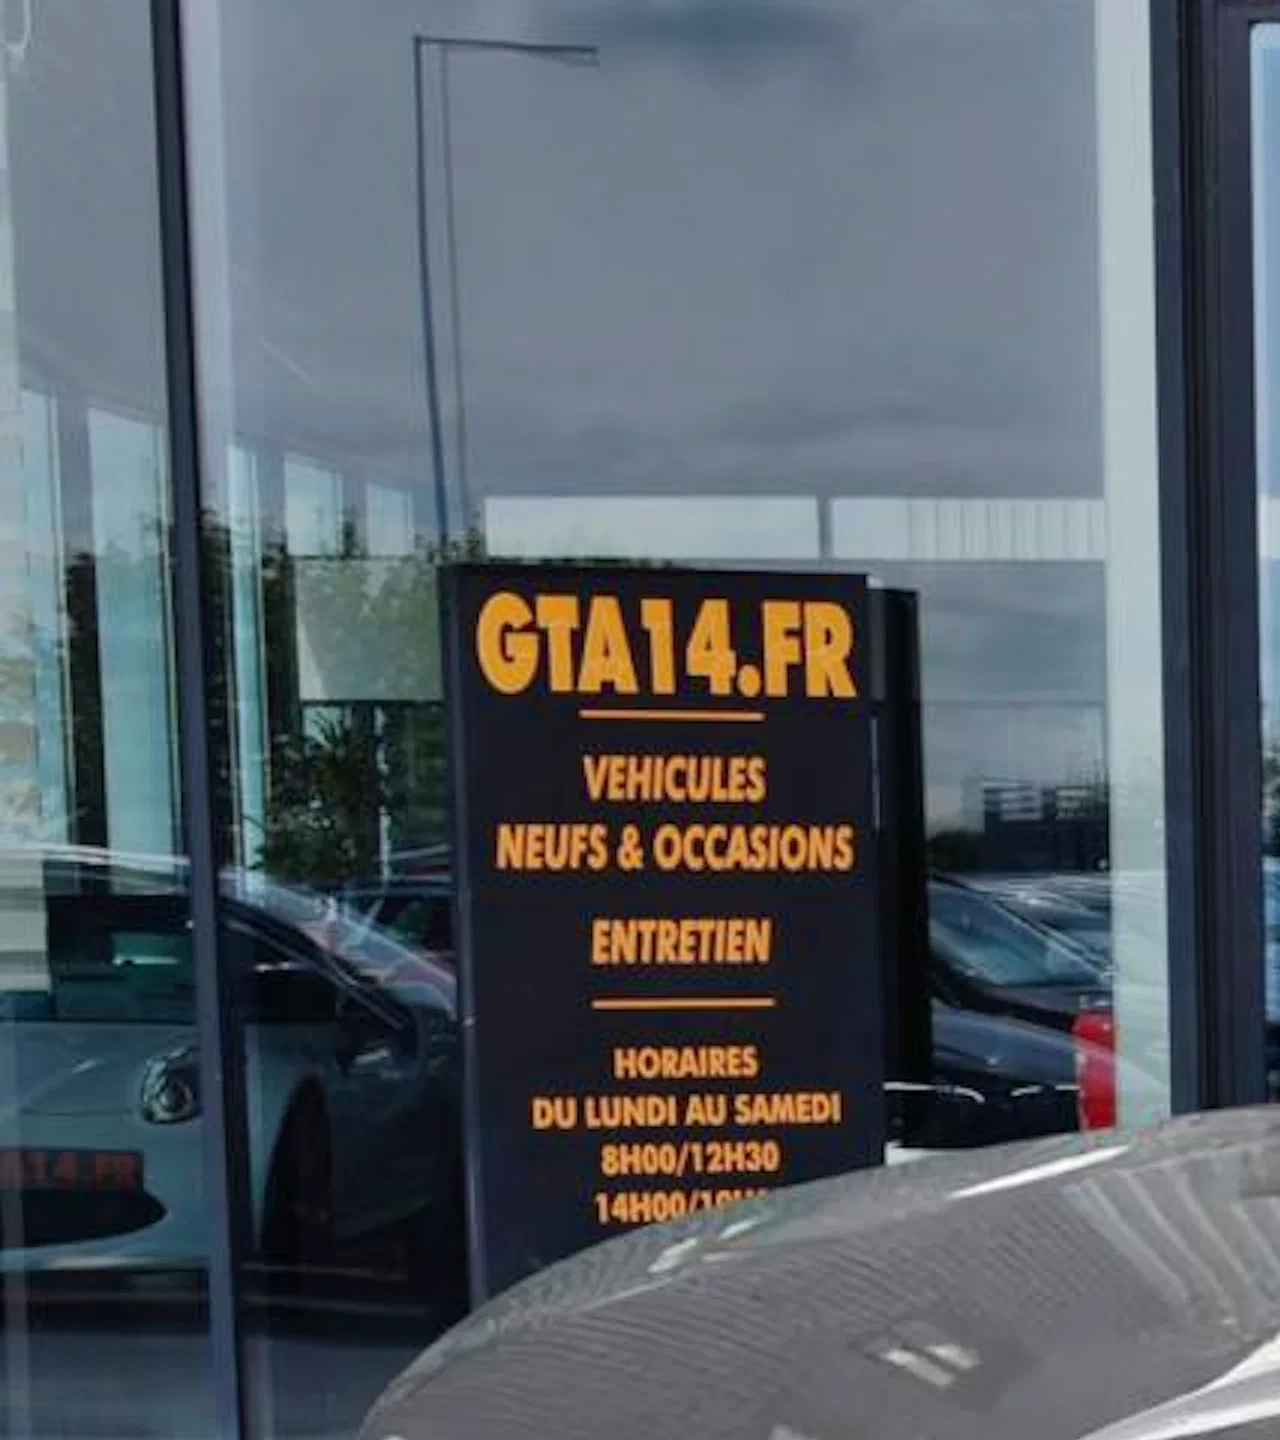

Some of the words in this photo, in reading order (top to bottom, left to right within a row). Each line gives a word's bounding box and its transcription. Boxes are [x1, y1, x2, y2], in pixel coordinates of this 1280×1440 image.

[477, 592, 856, 699] GTA14.FR
[583, 754, 766, 802] VEHICULES
[497, 825, 608, 870] NEUFS
[621, 827, 644, 871] &
[654, 824, 853, 872] OCCASIONS
[591, 919, 771, 965] ENTRETIEN
[614, 1045, 758, 1078] HORAIRES
[533, 1097, 576, 1129] DU
[586, 1096, 677, 1127] LUNDI
[686, 1095, 725, 1126] AU
[734, 1092, 840, 1124] SAMEDI
[601, 1141, 779, 1175] 8H00/12H30
